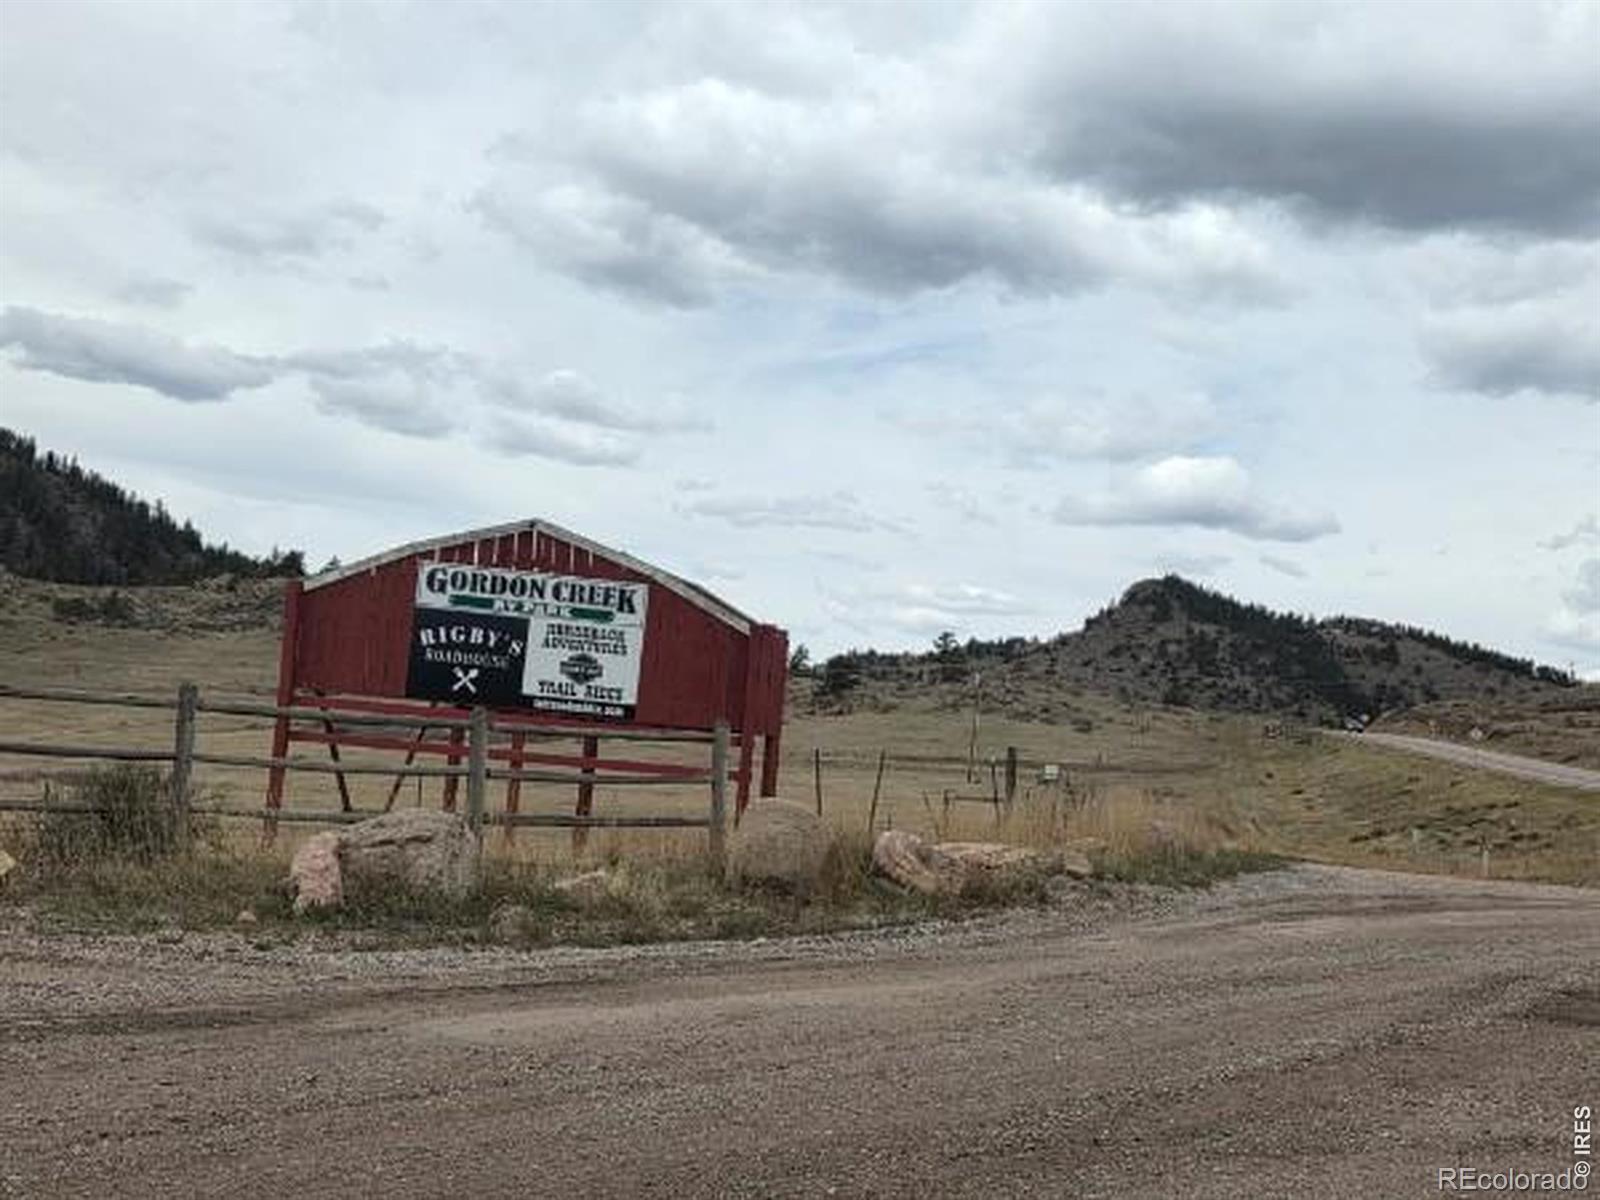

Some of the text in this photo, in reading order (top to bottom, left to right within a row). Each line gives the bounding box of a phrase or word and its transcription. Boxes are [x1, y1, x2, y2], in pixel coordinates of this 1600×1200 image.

[426, 567, 546, 600] GORDON
[552, 582, 637, 614] CREEK
[420, 626, 523, 656] RIGBY'S
[538, 680, 577, 697] TRAIL
